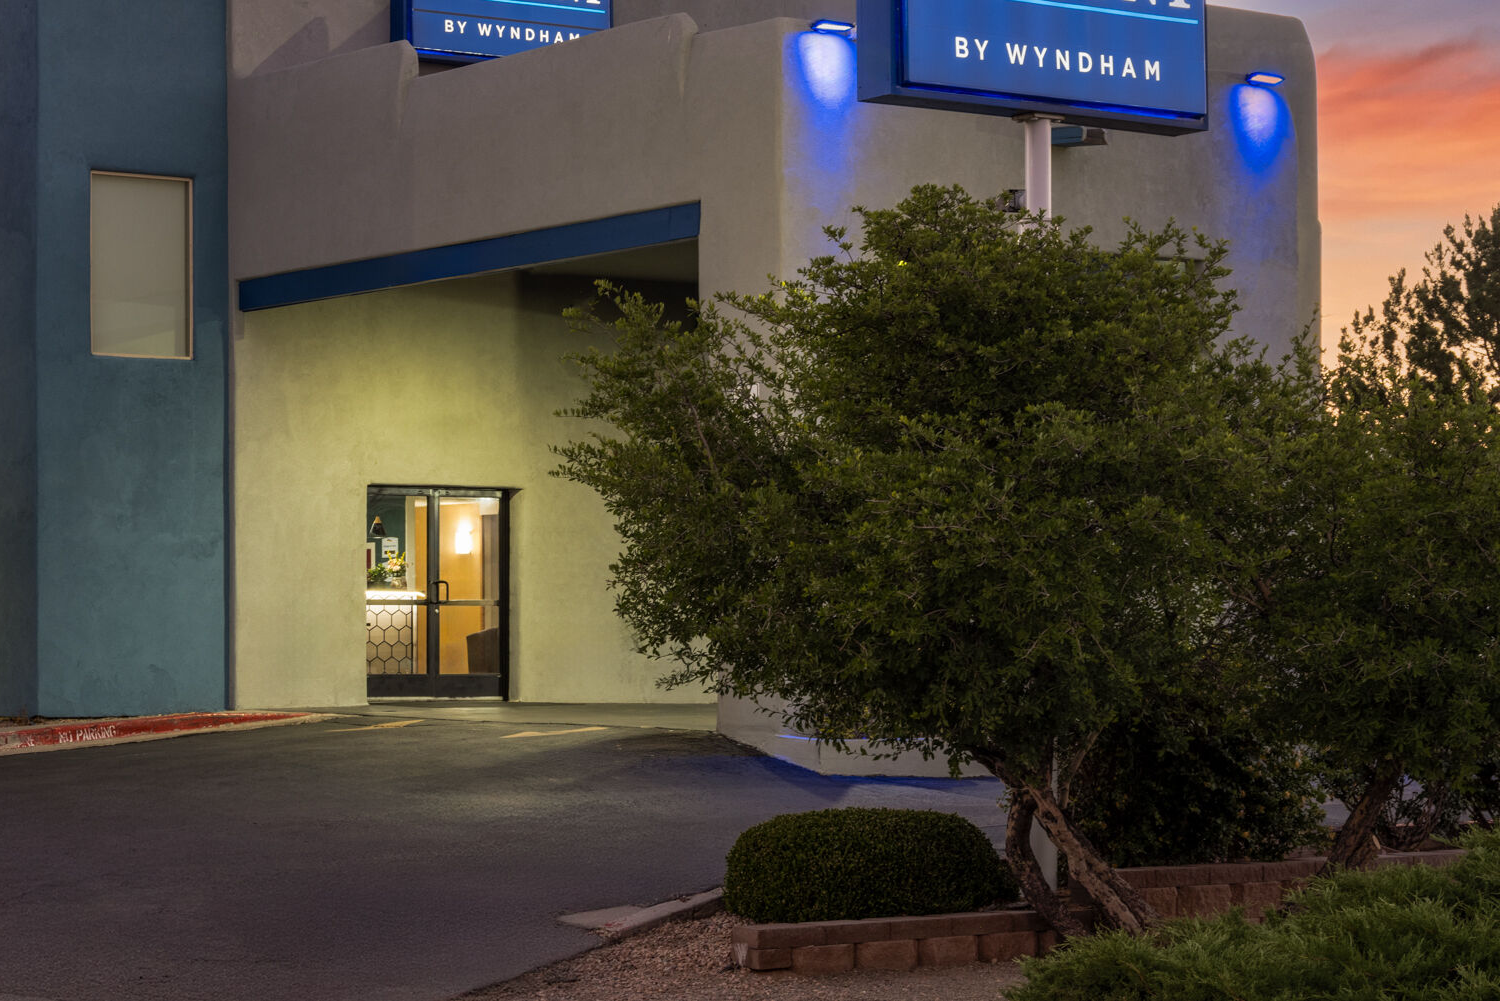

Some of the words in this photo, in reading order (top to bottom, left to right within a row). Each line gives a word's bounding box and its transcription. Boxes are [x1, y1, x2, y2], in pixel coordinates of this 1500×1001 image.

[444, 19, 467, 34] BY
[955, 36, 989, 61] BY
[1005, 42, 1161, 82] WYNDHAM
[76, 725, 116, 741] PARKING
